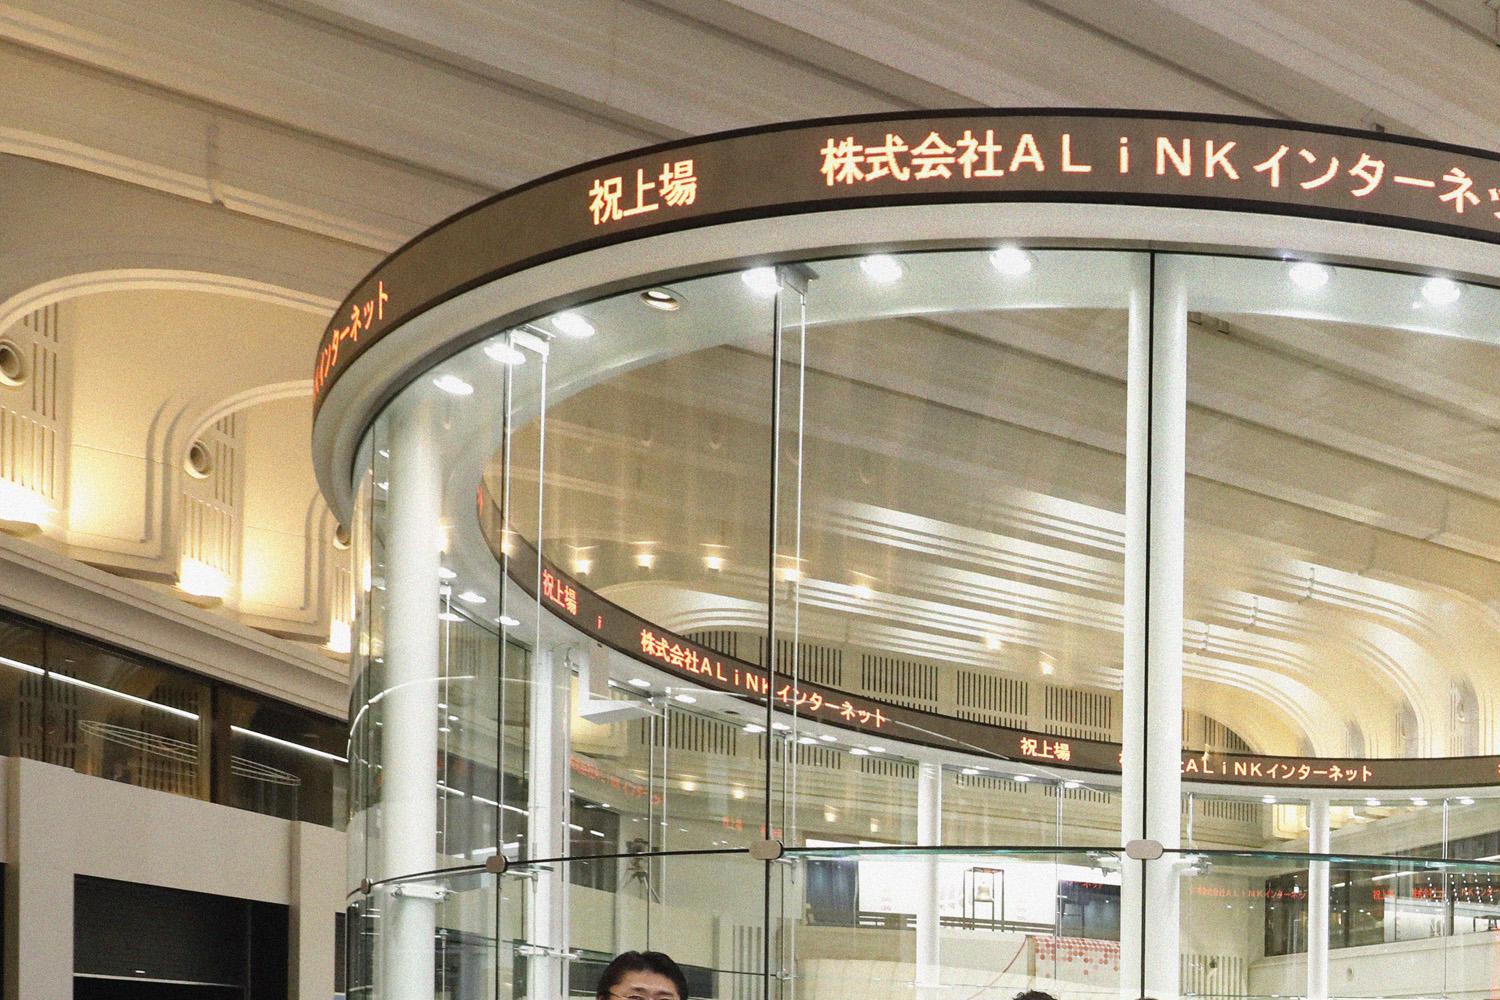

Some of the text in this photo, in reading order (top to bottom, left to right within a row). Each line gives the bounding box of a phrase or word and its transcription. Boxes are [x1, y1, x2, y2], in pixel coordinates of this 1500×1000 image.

[588, 159, 698, 226] 祝上場
[542, 568, 578, 616] 祝上場
[1020, 736, 1072, 761] 祝上場
